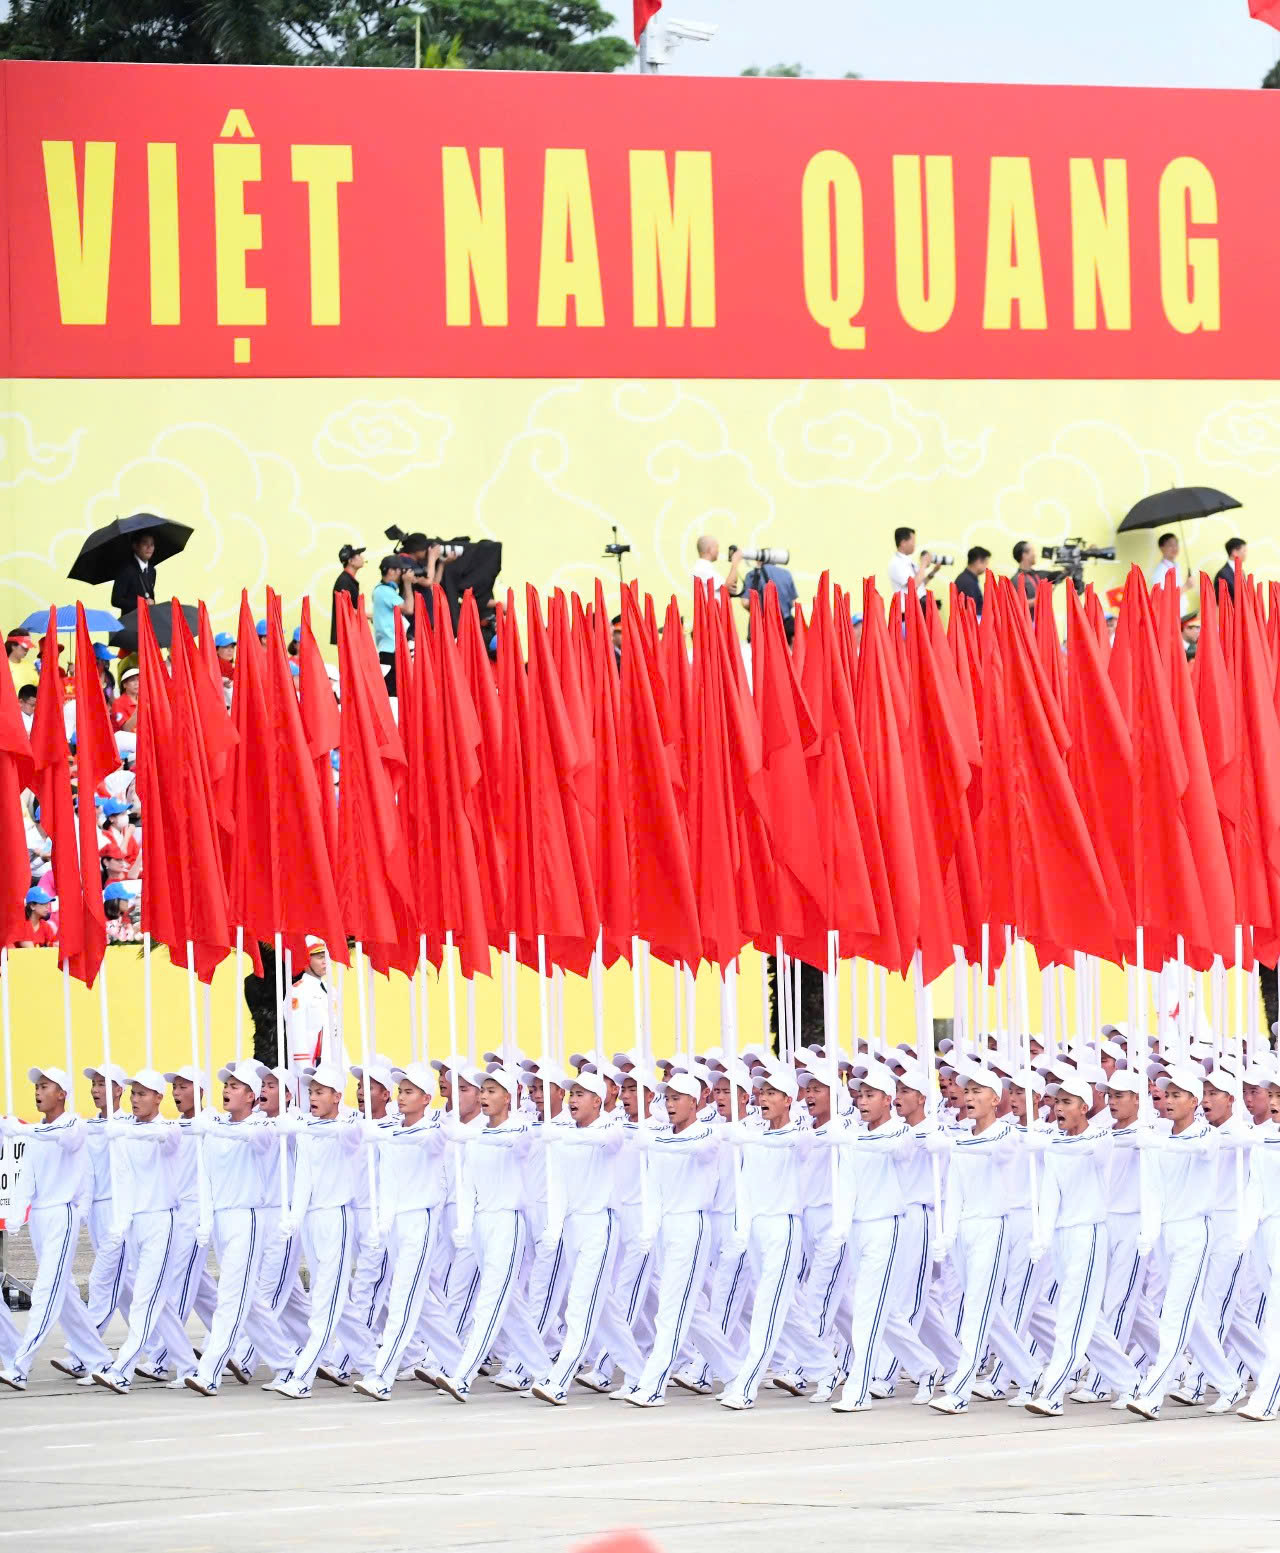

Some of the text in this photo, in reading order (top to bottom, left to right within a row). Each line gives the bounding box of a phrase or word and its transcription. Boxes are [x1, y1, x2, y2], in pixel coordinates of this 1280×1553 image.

[42, 109, 353, 363] VIỆT
[442, 146, 716, 328] NAM
[802, 150, 1220, 350] QUANG
